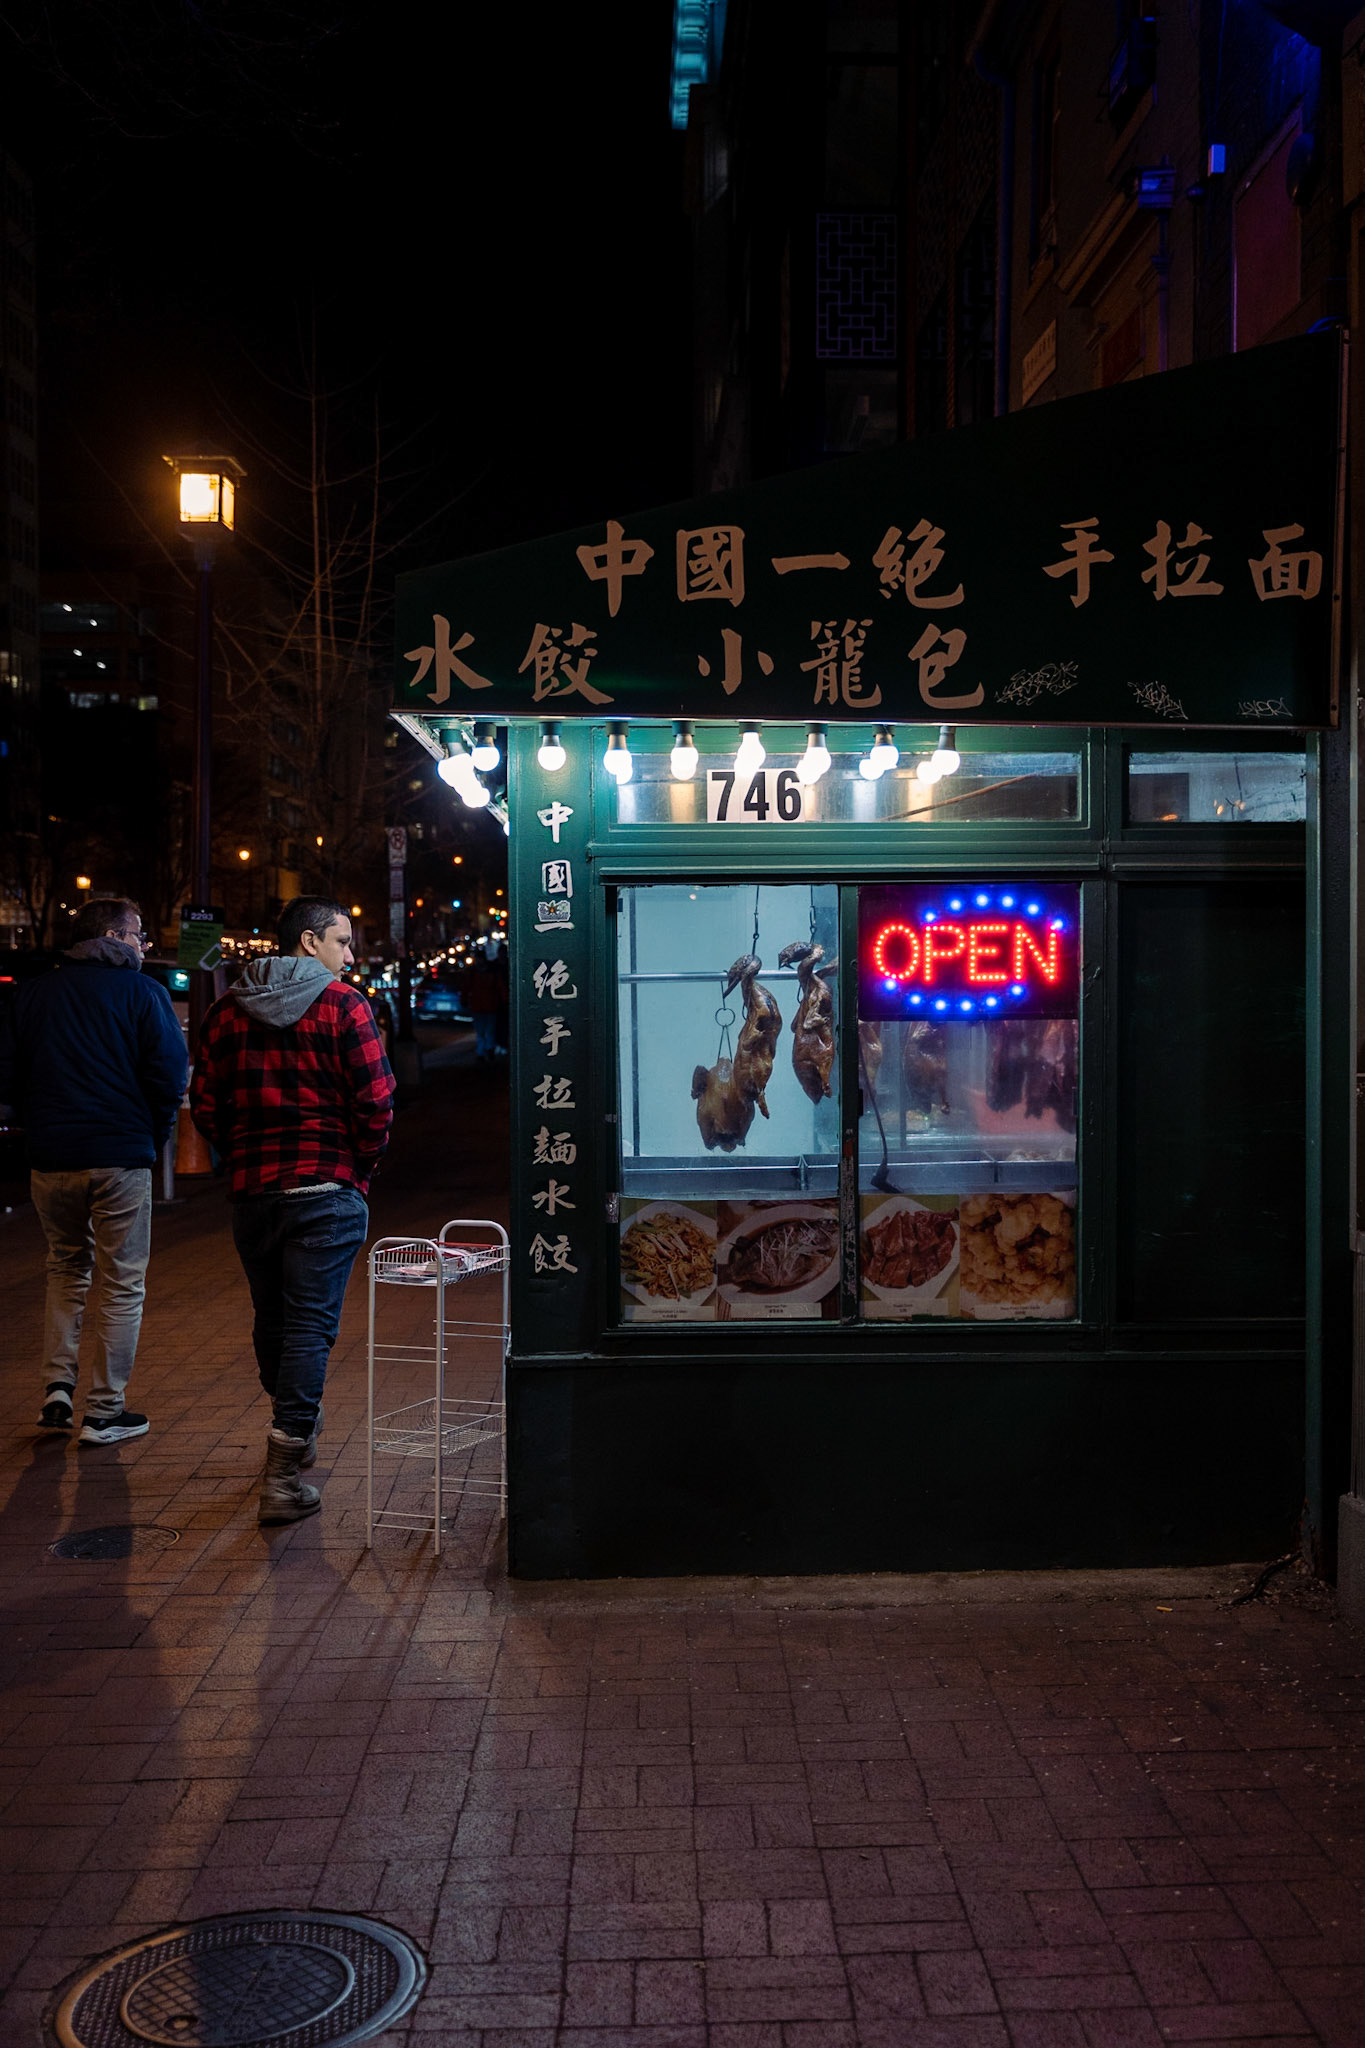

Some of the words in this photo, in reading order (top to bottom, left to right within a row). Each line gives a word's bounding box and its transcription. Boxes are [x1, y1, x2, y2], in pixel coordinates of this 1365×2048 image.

[575, 517, 966, 618] 中國一絕
[1040, 516, 1324, 608] 手拉面
[402, 613, 615, 705] 水餃
[697, 618, 985, 710] 小籠包
[711, 769, 802, 822] 746
[873, 923, 1058, 984] OPEN
